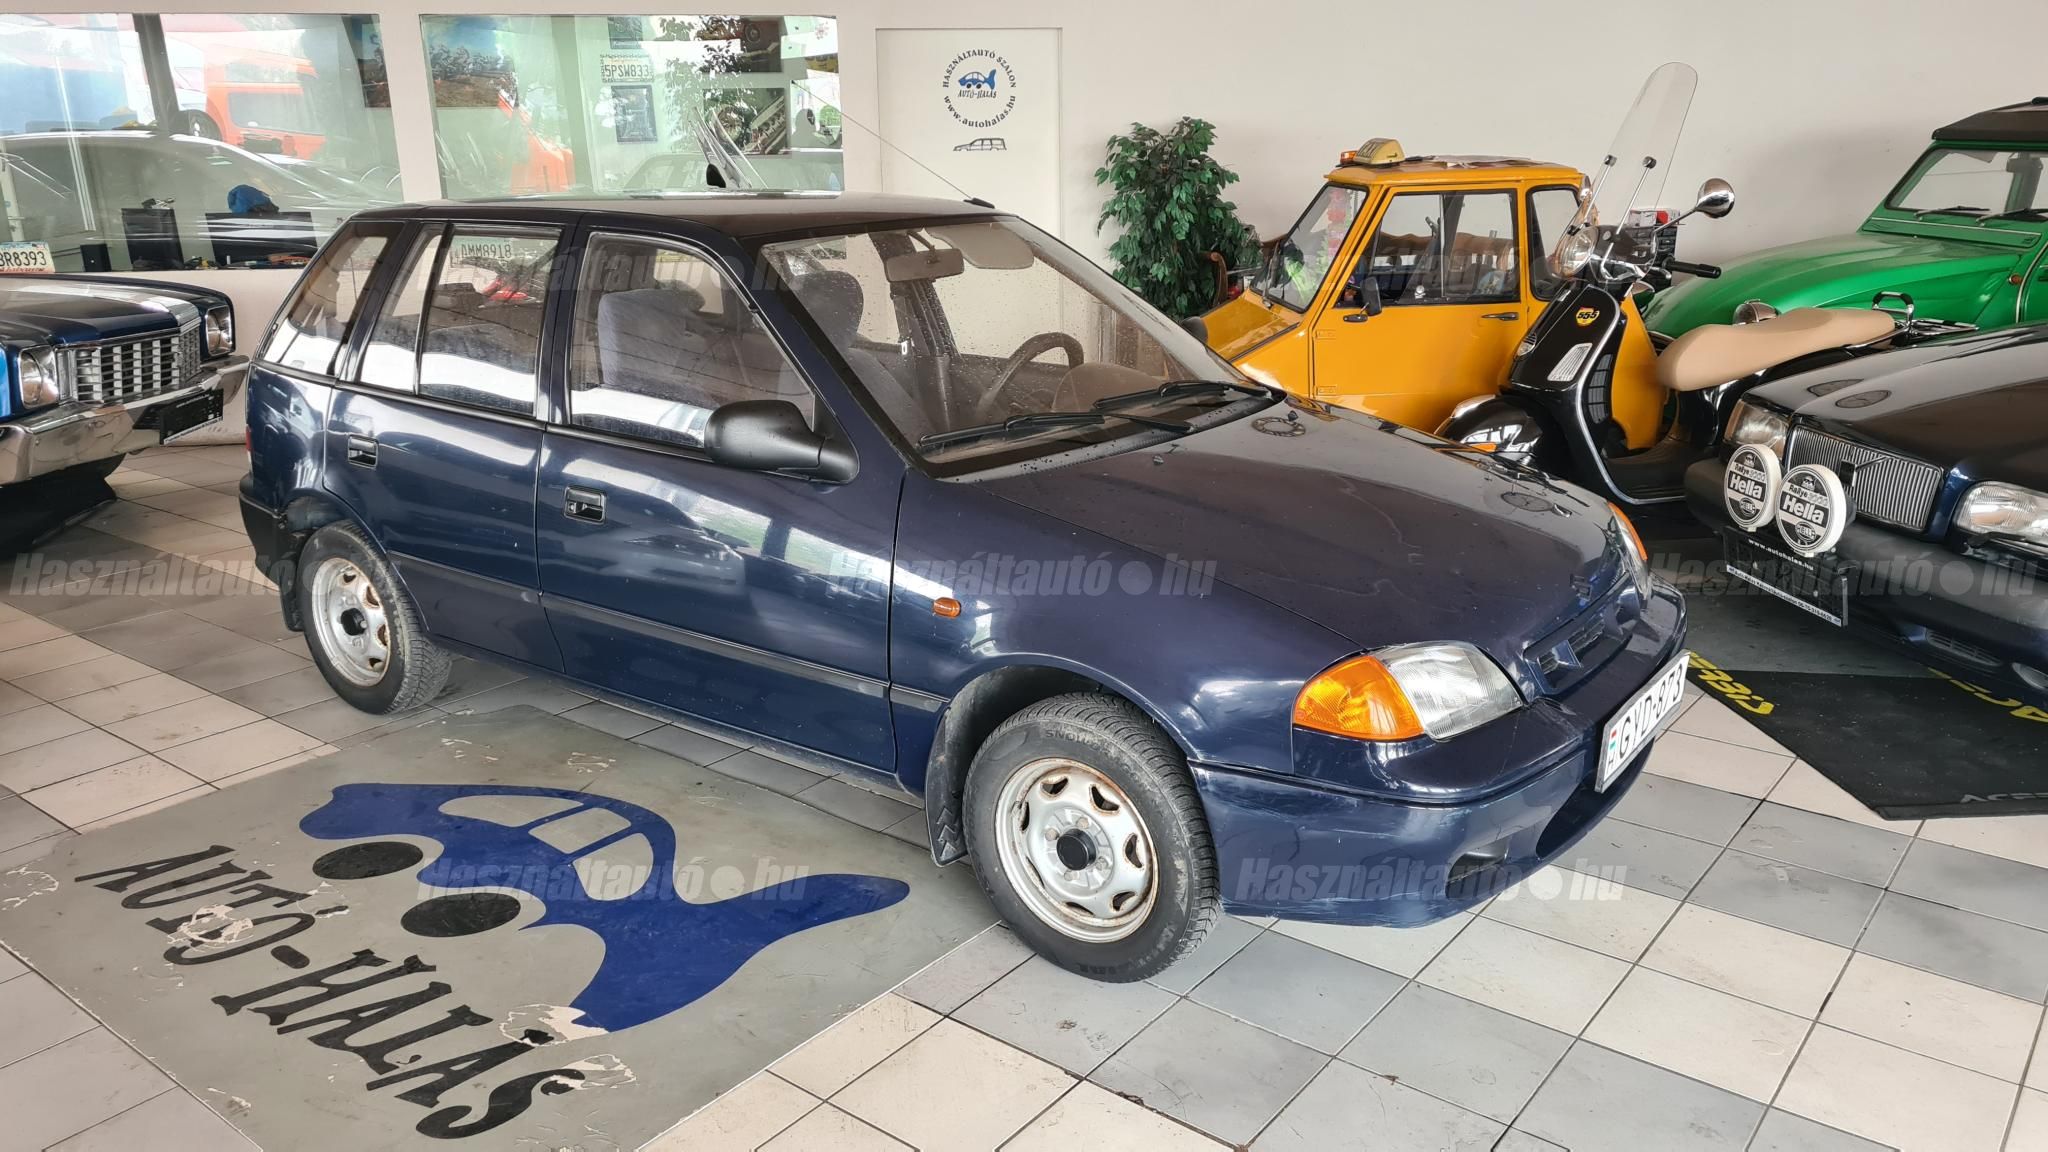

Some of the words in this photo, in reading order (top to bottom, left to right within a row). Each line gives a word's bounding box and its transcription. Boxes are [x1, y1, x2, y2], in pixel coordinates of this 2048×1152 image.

[943, 49, 996, 88] HASZNÁLTAUTÓ
[996, 56, 1017, 88] SZALON
[943, 95, 1016, 128] www.autohalas.hu
[1729, 473, 1763, 500] Hella
[1782, 493, 1825, 525] Hella
[1618, 663, 1684, 759] GYD-873
